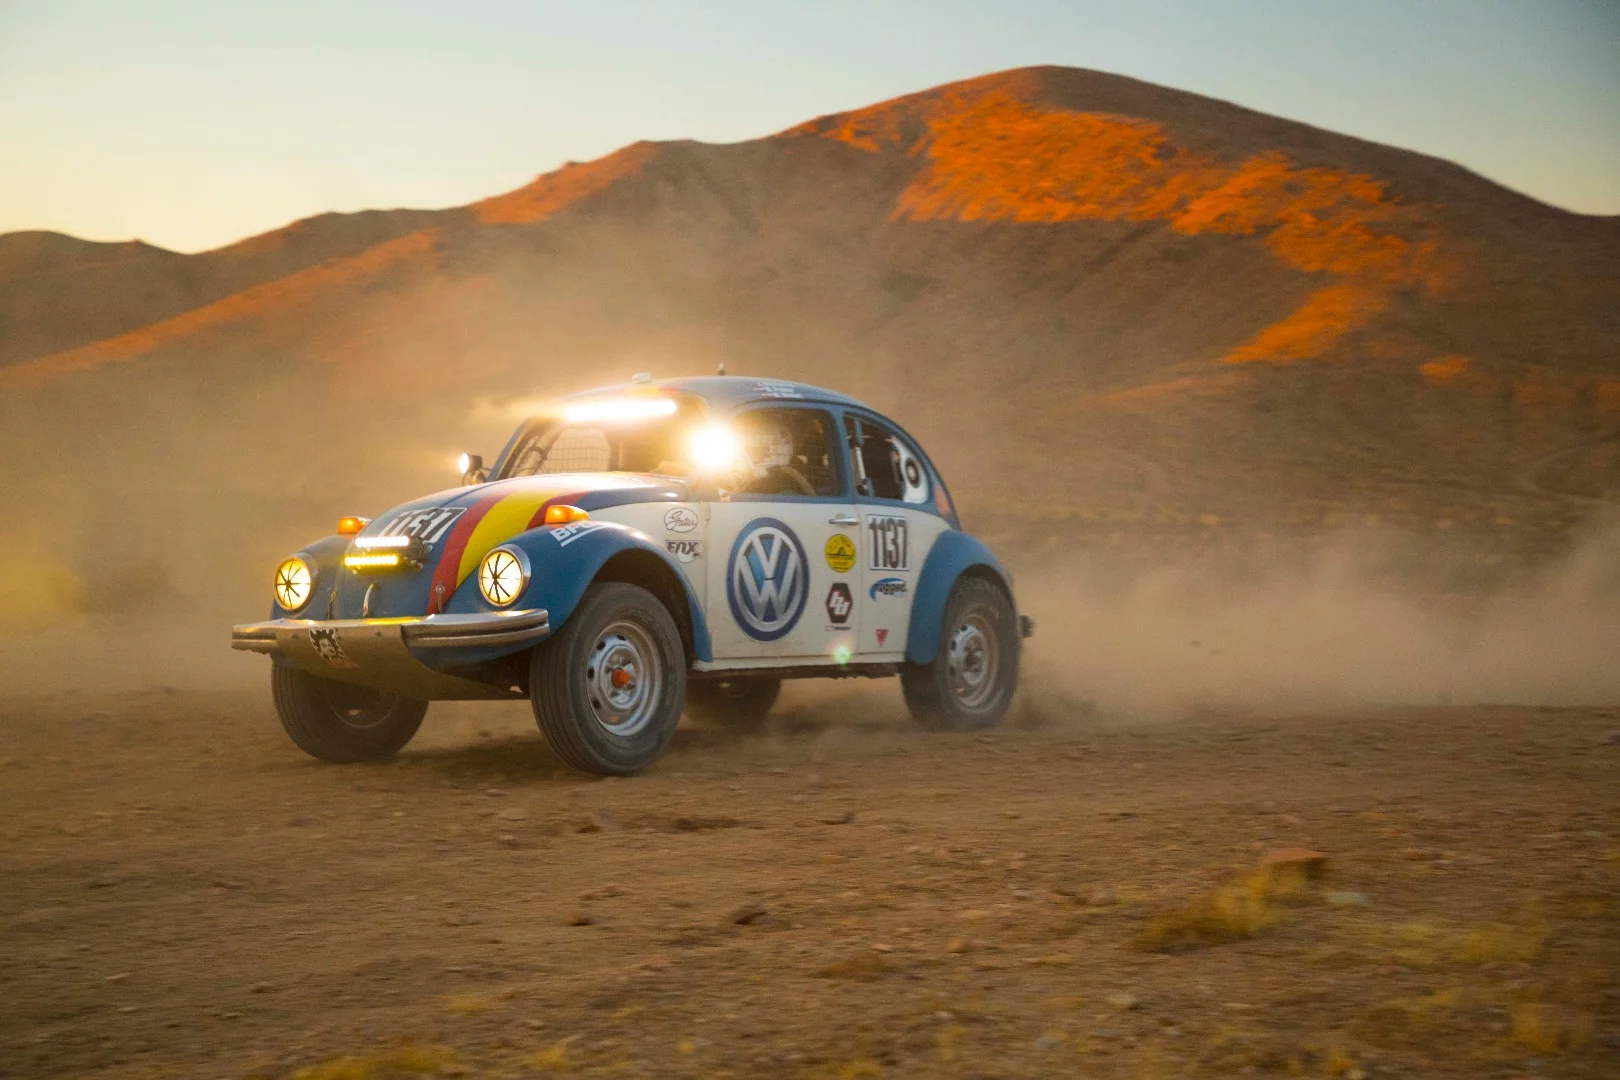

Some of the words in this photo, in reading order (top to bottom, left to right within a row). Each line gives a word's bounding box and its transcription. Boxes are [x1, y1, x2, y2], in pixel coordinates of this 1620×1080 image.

[667, 541, 698, 555] FOX
[868, 518, 907, 568] 1137
[736, 531, 801, 624] VW
